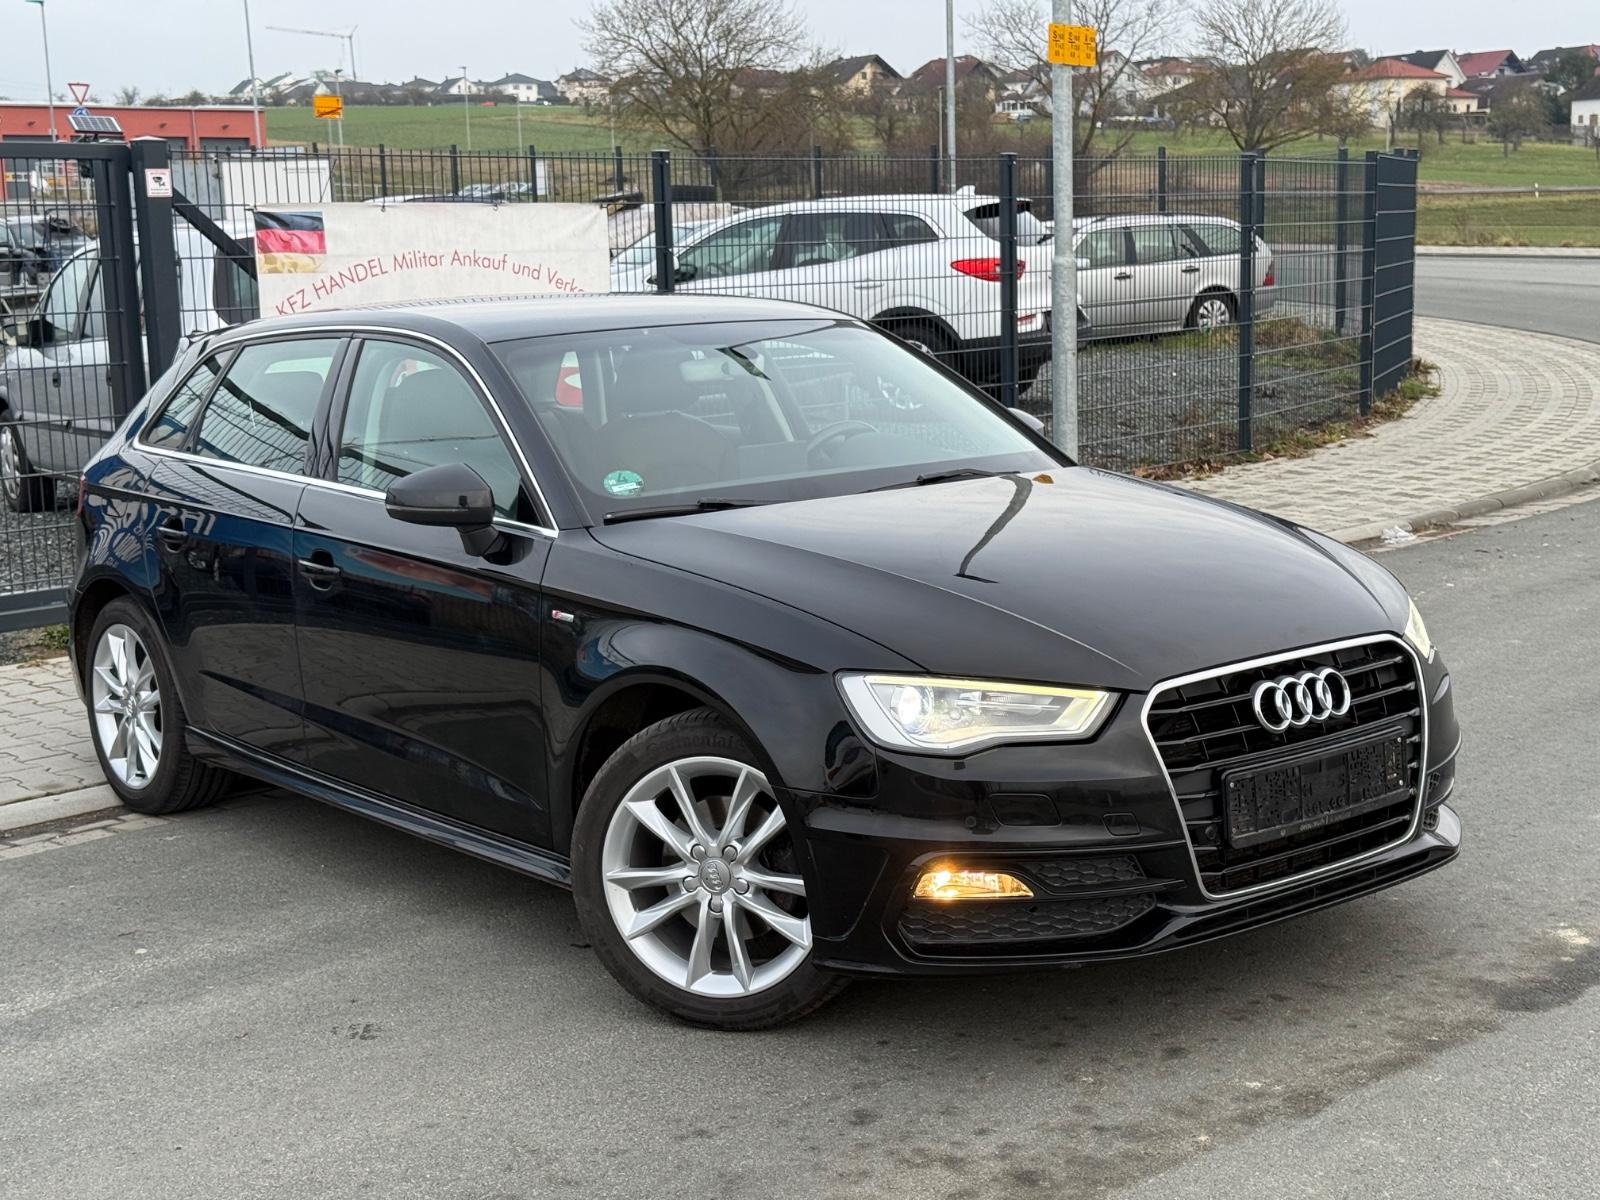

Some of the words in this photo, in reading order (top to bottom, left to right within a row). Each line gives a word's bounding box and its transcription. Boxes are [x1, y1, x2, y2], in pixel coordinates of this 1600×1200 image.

[275, 288, 312, 315] KFZ
[312, 257, 389, 299] HANDEL
[391, 250, 445, 272] Militar
[450, 248, 508, 271] Ankauf
[512, 262, 542, 281] und
